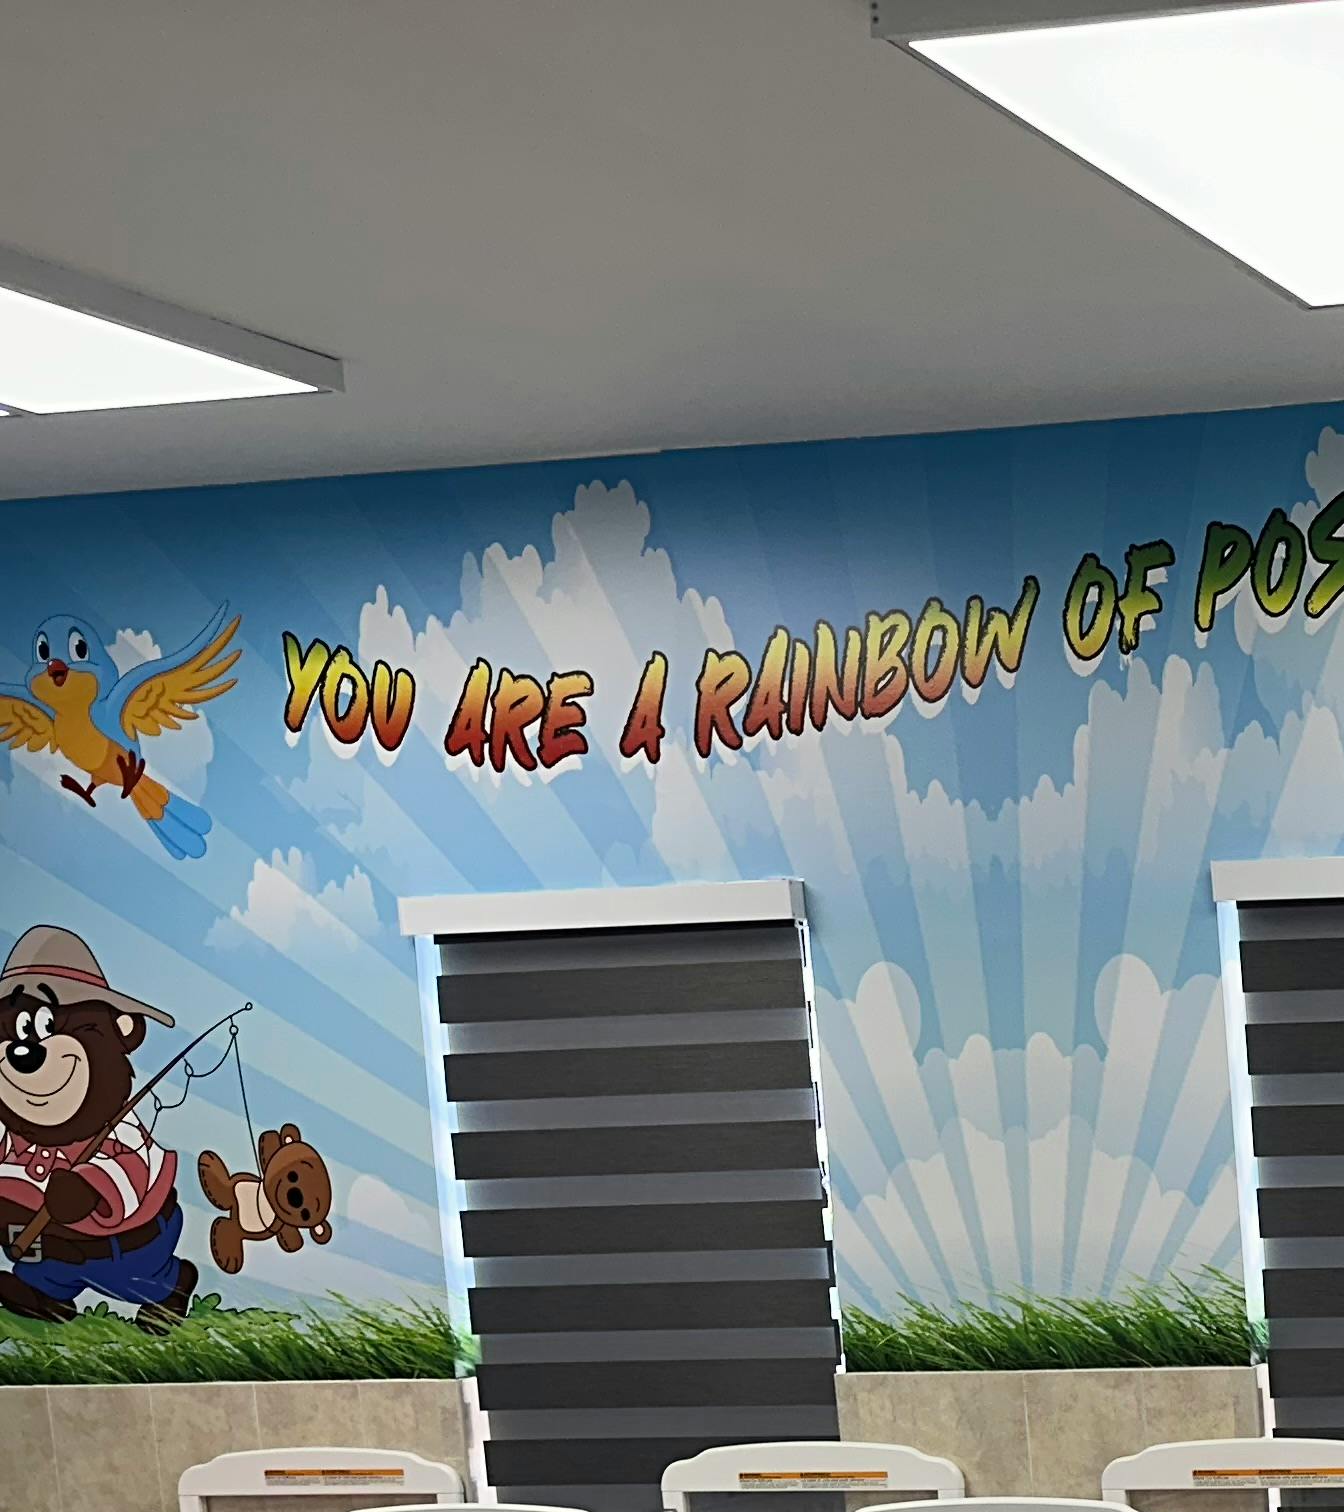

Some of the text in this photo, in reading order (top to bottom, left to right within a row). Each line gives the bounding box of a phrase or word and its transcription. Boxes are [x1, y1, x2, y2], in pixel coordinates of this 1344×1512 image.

[282, 630, 415, 751] YOU
[444, 657, 594, 773] ARE
[619, 650, 668, 764] A
[693, 576, 1040, 759] RAINBOW
[1062, 538, 1175, 661] OF
